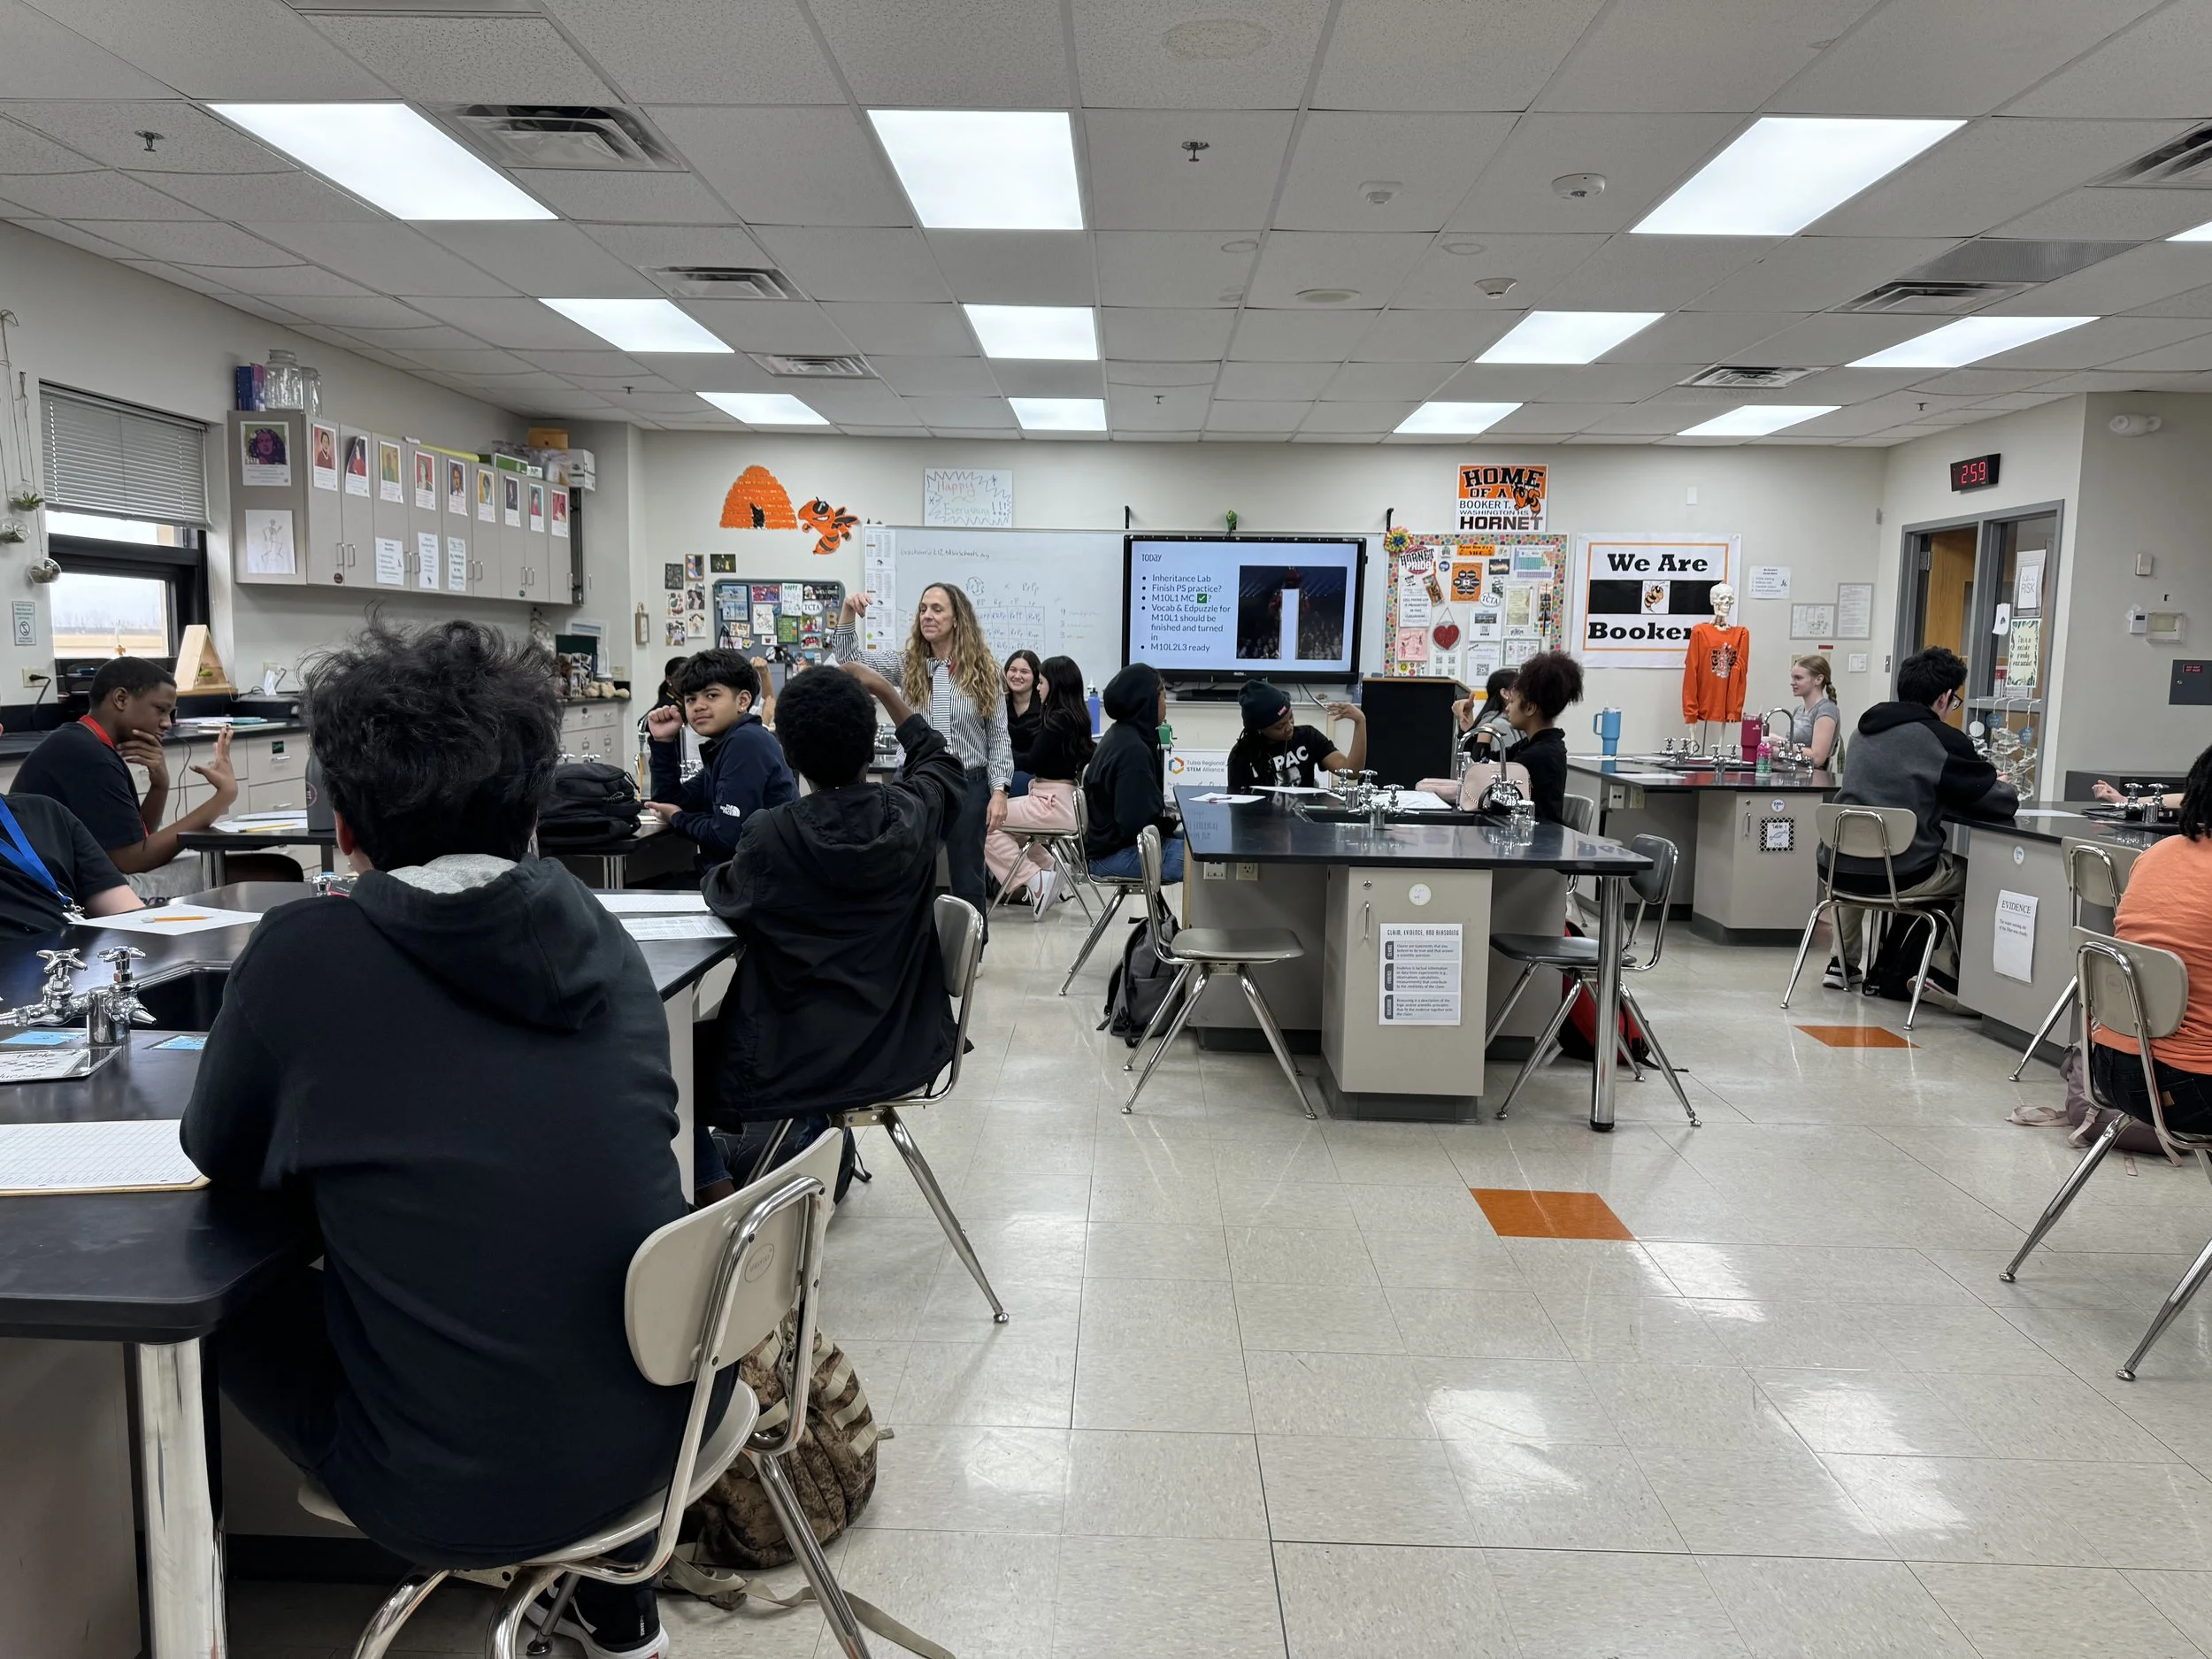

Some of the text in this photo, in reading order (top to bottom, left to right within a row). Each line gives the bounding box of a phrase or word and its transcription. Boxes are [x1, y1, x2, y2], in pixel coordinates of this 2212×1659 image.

[1463, 467, 1544, 488] HOME
[938, 480, 976, 496] Happy
[1470, 488, 1507, 498] OF A
[1459, 500, 1511, 509] BOOKER T.
[1459, 517, 1543, 530] HORNET
[1400, 548, 1435, 566] HORNET
[1607, 553, 1709, 572] We Are
[1152, 574, 1196, 583] Inheritance
[1187, 585, 1222, 595] practice?
[2021, 583, 2036, 594] RISK
[1151, 594, 1179, 603] M10L1
[1180, 594, 1194, 603] MC
[1482, 595, 1498, 605] TCTA
[1151, 603, 1175, 612] Vocab
[1184, 604, 1218, 616] Edpuzzle
[1151, 613, 1179, 622] M10L1
[1206, 614, 1217, 623] be
[1587, 622, 1692, 640] Booker
[1188, 644, 1210, 653] ready
[2001, 900, 2032, 915] EVIDENCE
